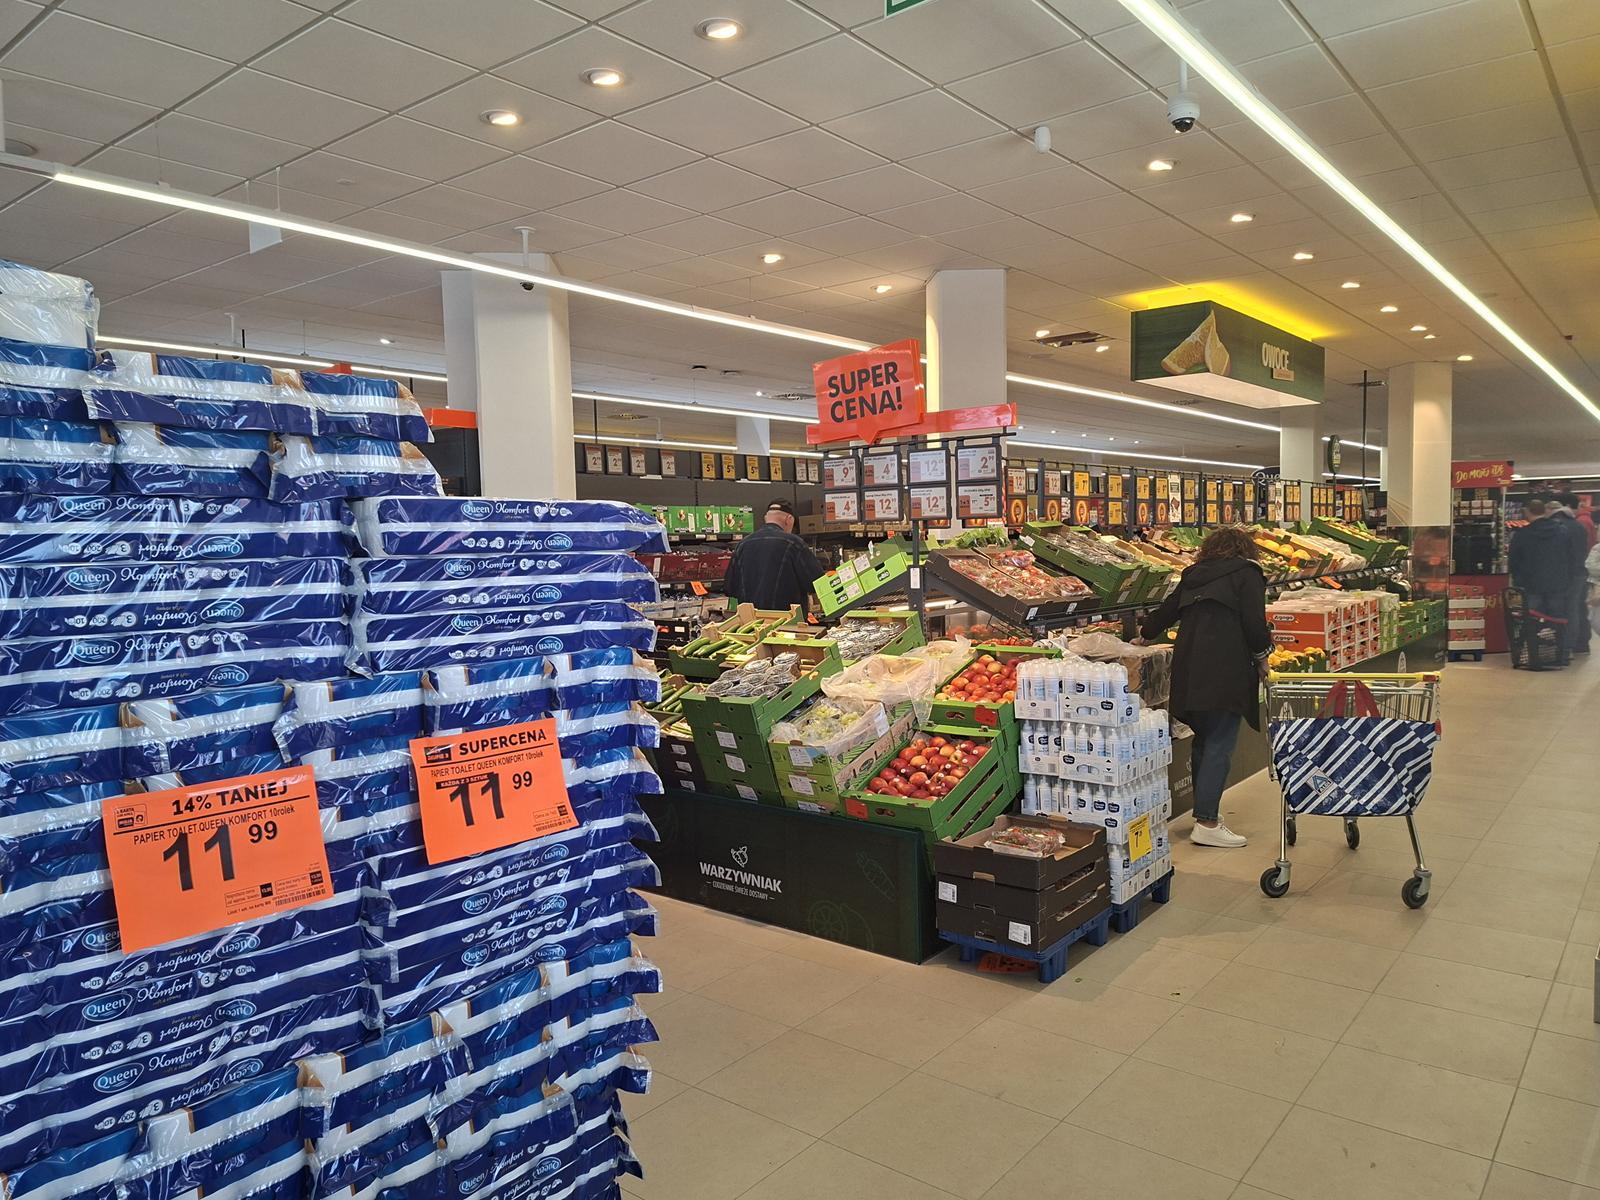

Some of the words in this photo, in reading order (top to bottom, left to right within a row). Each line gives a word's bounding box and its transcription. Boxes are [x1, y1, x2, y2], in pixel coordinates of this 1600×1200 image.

[1262, 342, 1289, 371] OWOCE
[828, 361, 899, 398] SUPER
[831, 387, 903, 423] CENA!
[842, 467, 849, 478] 9
[883, 464, 890, 475] 4
[926, 460, 938, 472] 12
[981, 457, 988, 469] 2
[64, 498, 106, 514] Queen
[116, 497, 172, 513] Komfort
[464, 504, 490, 514] Queen
[496, 503, 530, 514] Komfort
[844, 501, 850, 512] 4
[880, 499, 891, 510] 12
[927, 496, 938, 508] 12
[984, 497, 990, 506] 5
[139, 544, 193, 558] Komfort
[202, 542, 239, 554] Queen
[508, 539, 542, 550] Komfort
[548, 540, 570, 548] Queen
[446, 562, 472, 573] Queen
[478, 558, 516, 570] Komfort
[68, 572, 110, 584] Queen
[121, 568, 178, 584] Komfort
[494, 592, 530, 604] Komfort
[536, 589, 560, 598] Queen
[144, 610, 198, 626] Komfort
[206, 608, 242, 618] Queen
[454, 618, 479, 628] Queen
[484, 614, 520, 626] Komfort
[74, 644, 115, 656] Queen
[125, 633, 180, 652] Komfort
[190, 638, 196, 647] 3
[500, 644, 534, 656] Komfort
[539, 642, 560, 650] Queen
[150, 678, 202, 694] Komfort
[212, 670, 245, 682] Queen
[460, 729, 547, 756] SUPERCENA
[431, 768, 450, 778] PAPIER
[498, 755, 524, 766] KOMFORT
[525, 751, 544, 760] 10rolek
[172, 794, 212, 816] 14%
[450, 772, 504, 827] 11
[512, 771, 533, 790] 99
[133, 830, 165, 844] PAPIER
[228, 810, 267, 825] KOMFORT
[268, 806, 296, 818] 10rolek
[163, 824, 235, 892] 11
[248, 820, 278, 844] 99
[508, 856, 540, 874] Komfort
[544, 848, 567, 860] Queen
[700, 861, 782, 893] WARZYWNIAK
[464, 897, 488, 911] Queen
[492, 880, 530, 900] Komfort
[156, 950, 212, 972] Komfort
[222, 936, 258, 954] Queen
[86, 997, 127, 1016] Queen
[138, 976, 193, 1003] Komfort
[203, 976, 210, 985] 3
[142, 1033, 148, 1042] 3
[160, 1014, 212, 1041] Komfort
[218, 1004, 253, 1018] Queen
[98, 1066, 138, 1088] Queen
[149, 1044, 204, 1071] Komfort
[153, 1102, 160, 1111] 3
[170, 1078, 220, 1108] Komfort
[537, 1160, 560, 1172] Queen
[462, 1172, 485, 1191] Queen
